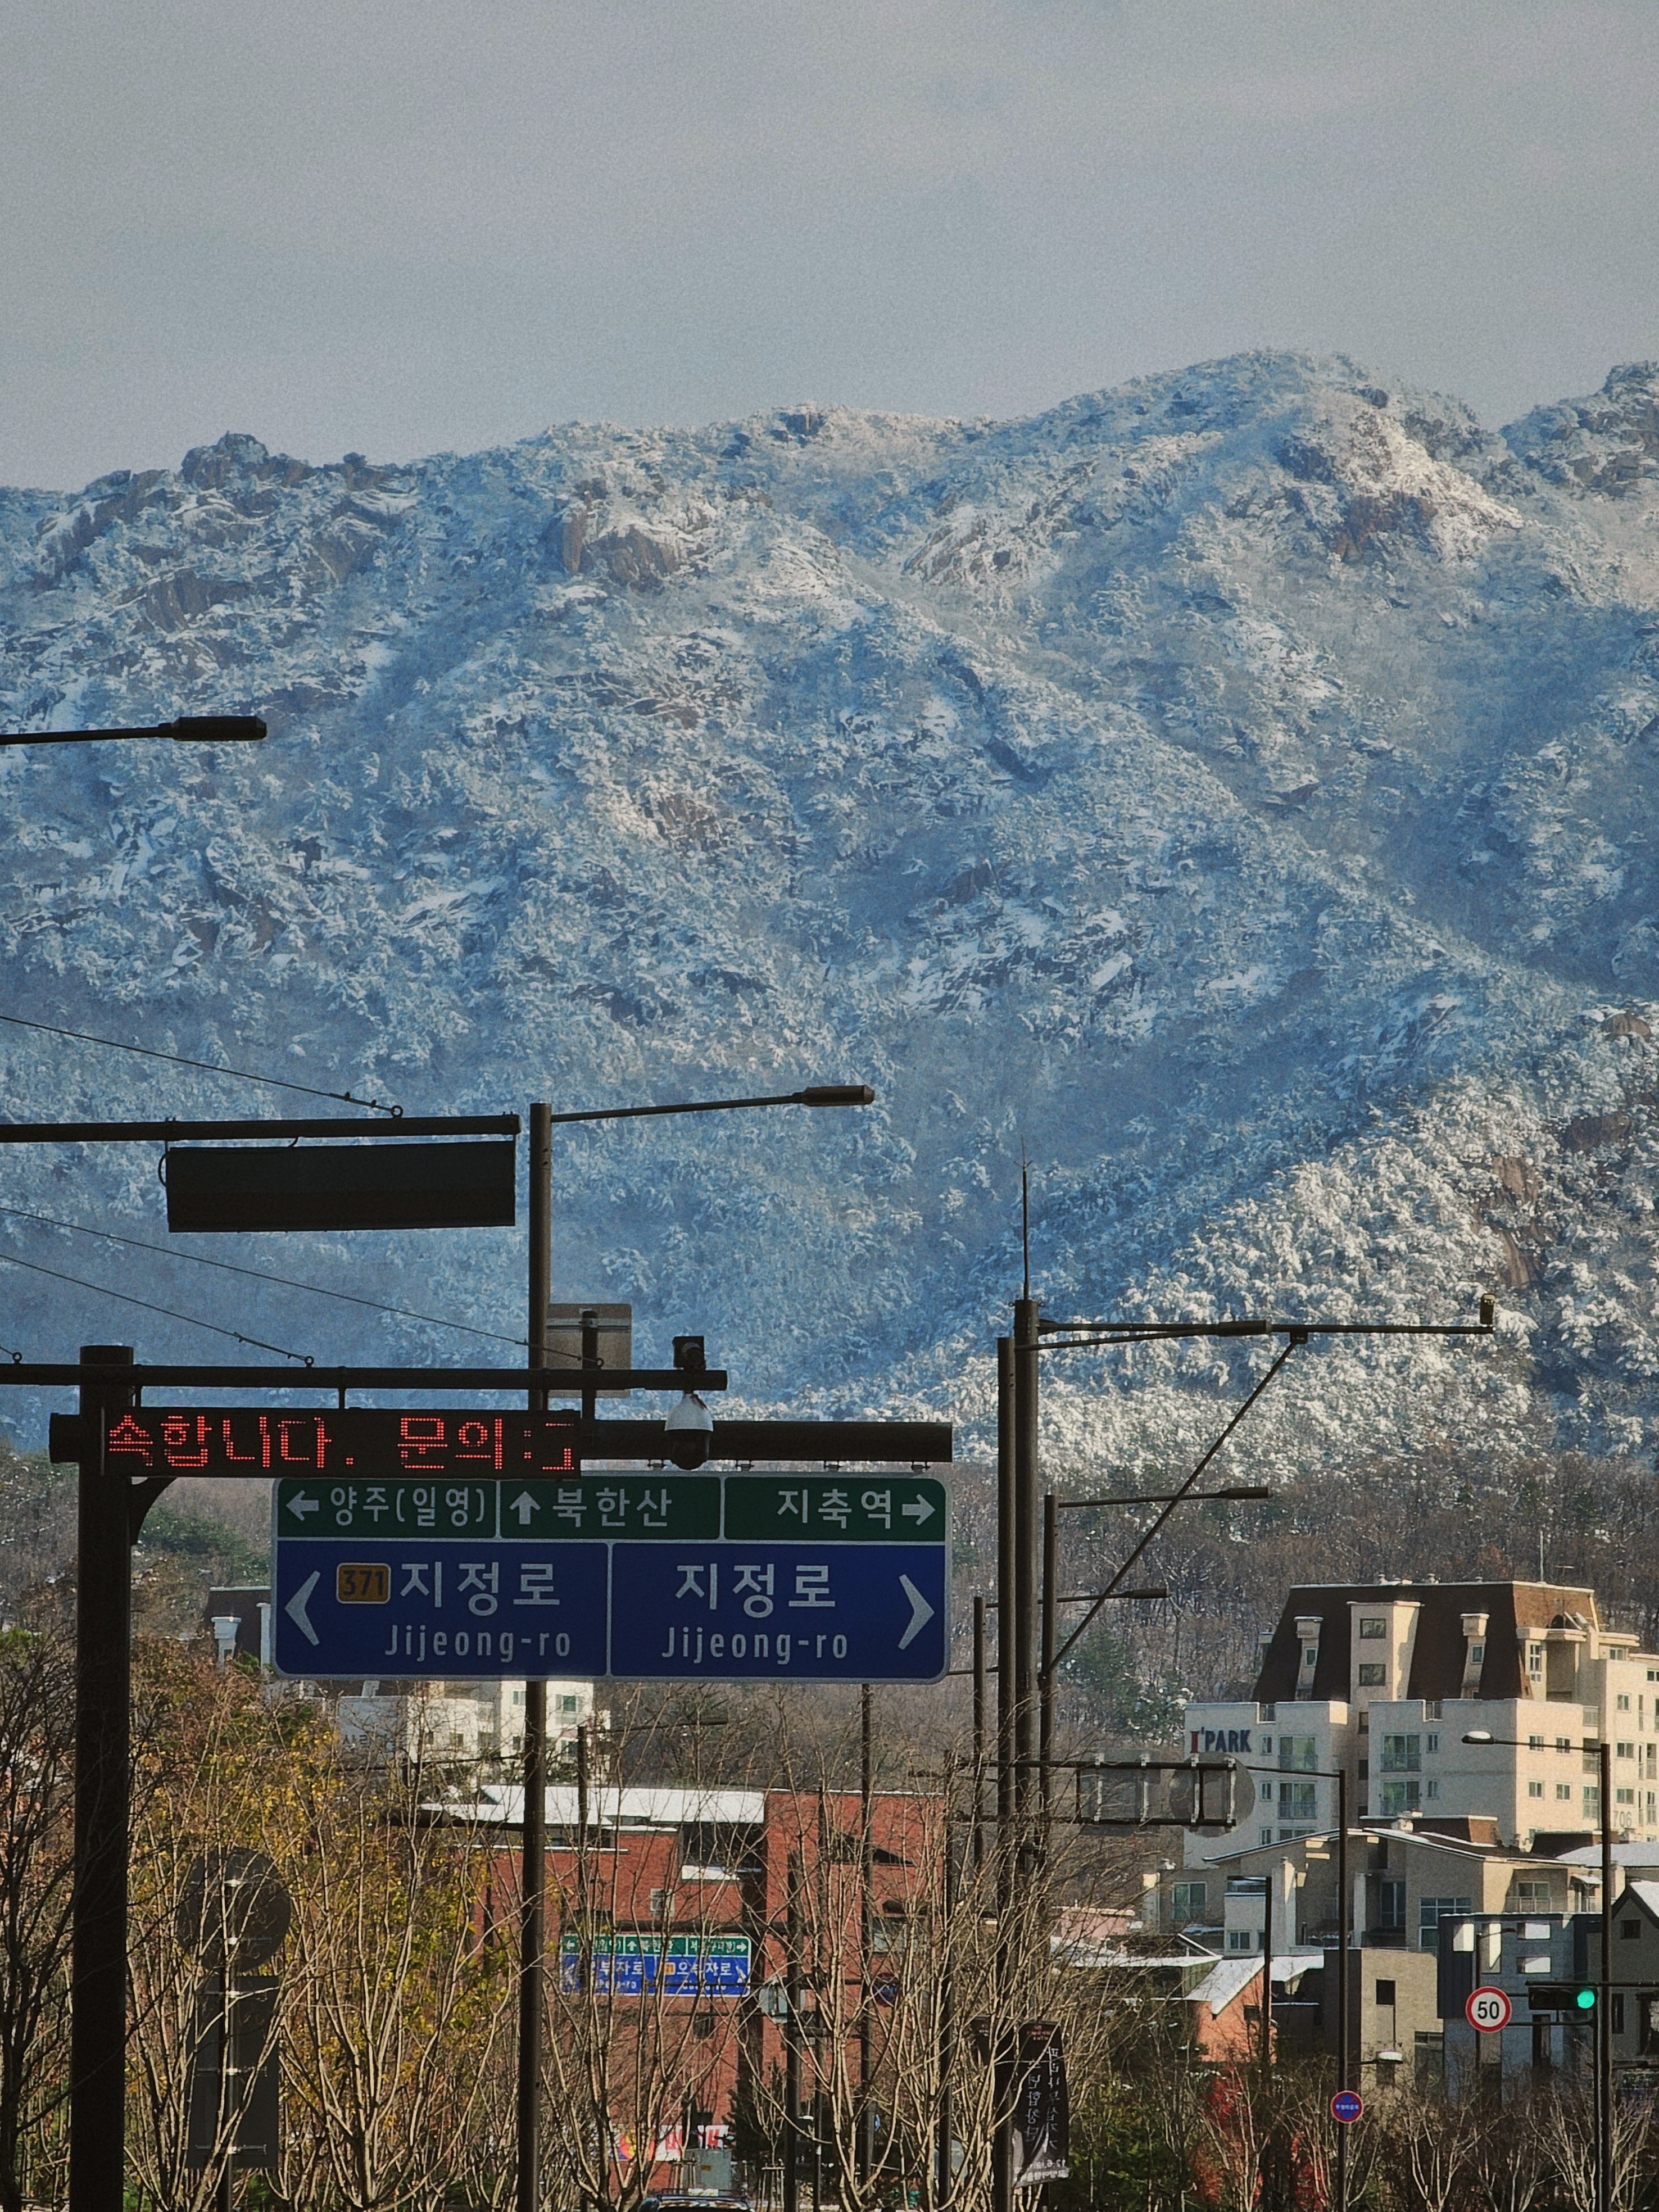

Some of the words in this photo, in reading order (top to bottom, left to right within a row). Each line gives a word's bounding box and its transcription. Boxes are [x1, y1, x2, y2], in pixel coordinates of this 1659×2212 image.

[109, 1415, 354, 1468] 속합니다.
[330, 1486, 484, 1527] 양주(일영)
[553, 1488, 672, 1527] 북한산
[777, 1489, 891, 1529] 지축역
[343, 1570, 384, 1597] 371
[400, 1561, 560, 1617] 지정로
[675, 1563, 836, 1619] 지정로
[385, 1625, 570, 1662] Jijeong-ro
[661, 1626, 848, 1665] Jijeong-ro
[1190, 1726, 1252, 1753] I'PARK
[1613, 1810, 1632, 1828] 706
[1477, 2001, 1499, 2019] 50
